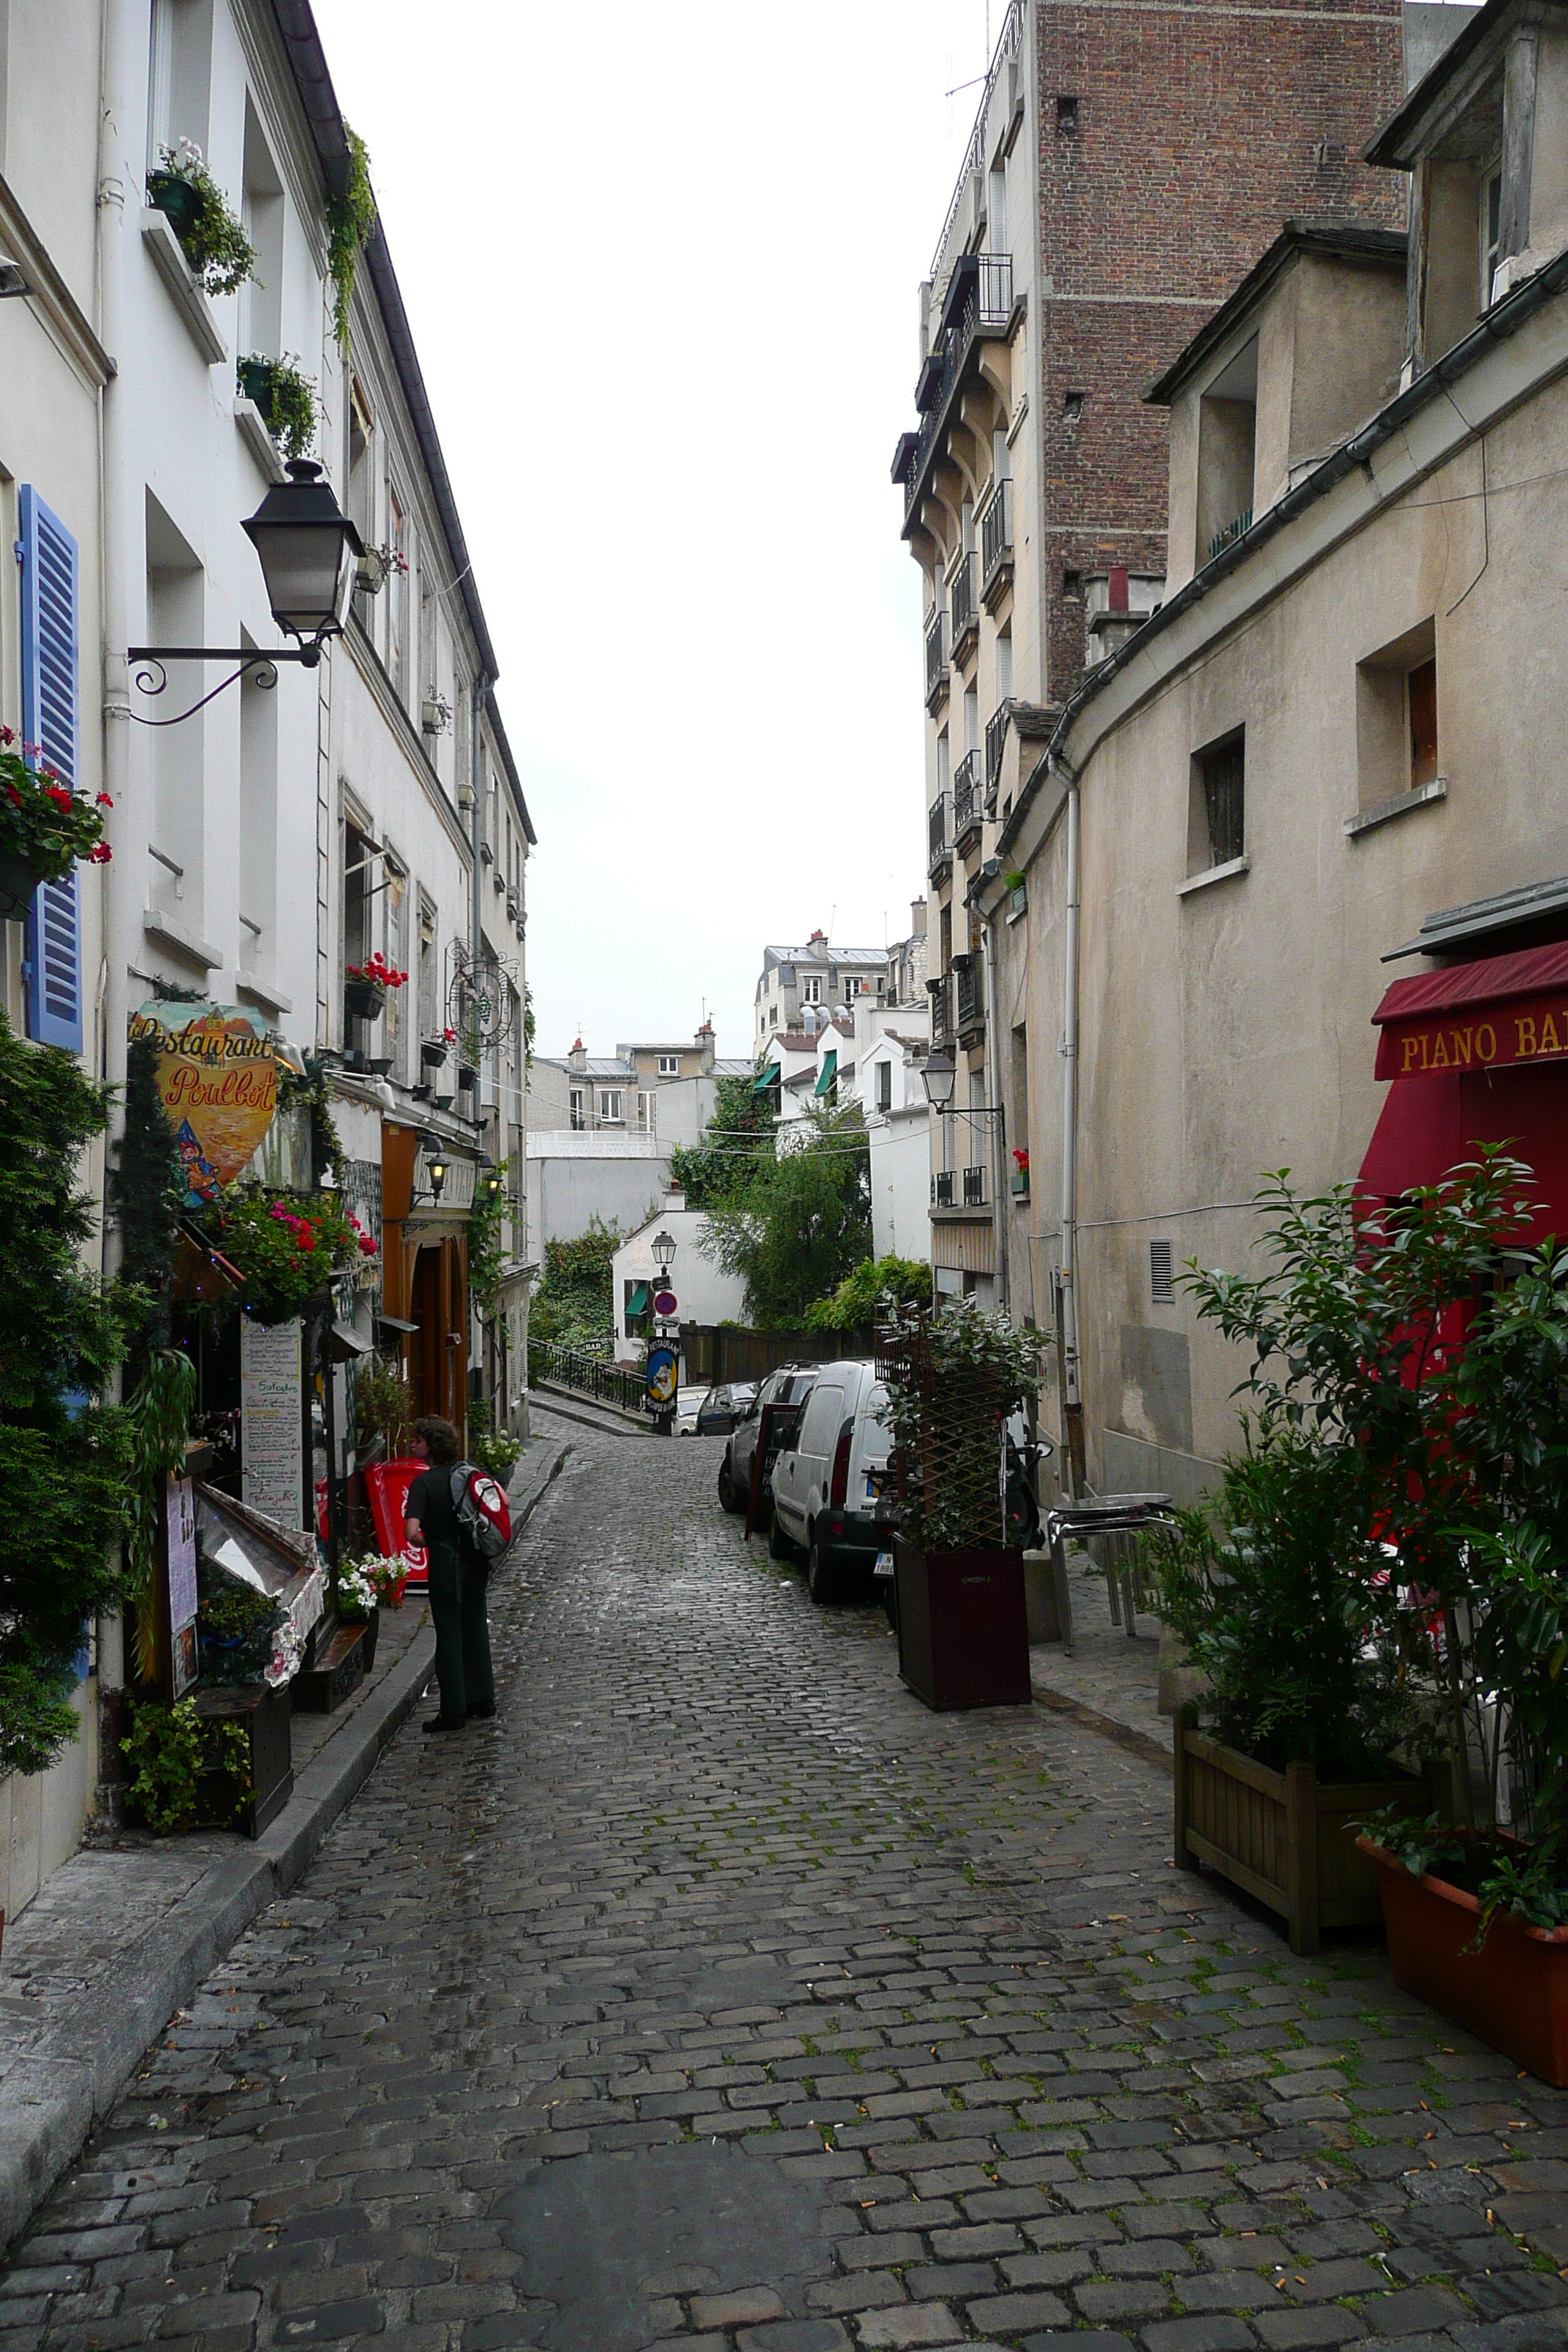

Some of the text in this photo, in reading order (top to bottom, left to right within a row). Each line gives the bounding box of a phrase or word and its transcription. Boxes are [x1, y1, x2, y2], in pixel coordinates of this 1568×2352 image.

[132, 1017, 272, 1059] Restaurant
[1401, 1011, 1568, 1072] PIANO BA
[165, 1066, 276, 1112] Poulbot
[585, 1343, 602, 1351] BAR
[649, 1339, 680, 1355] RESTAURANT
